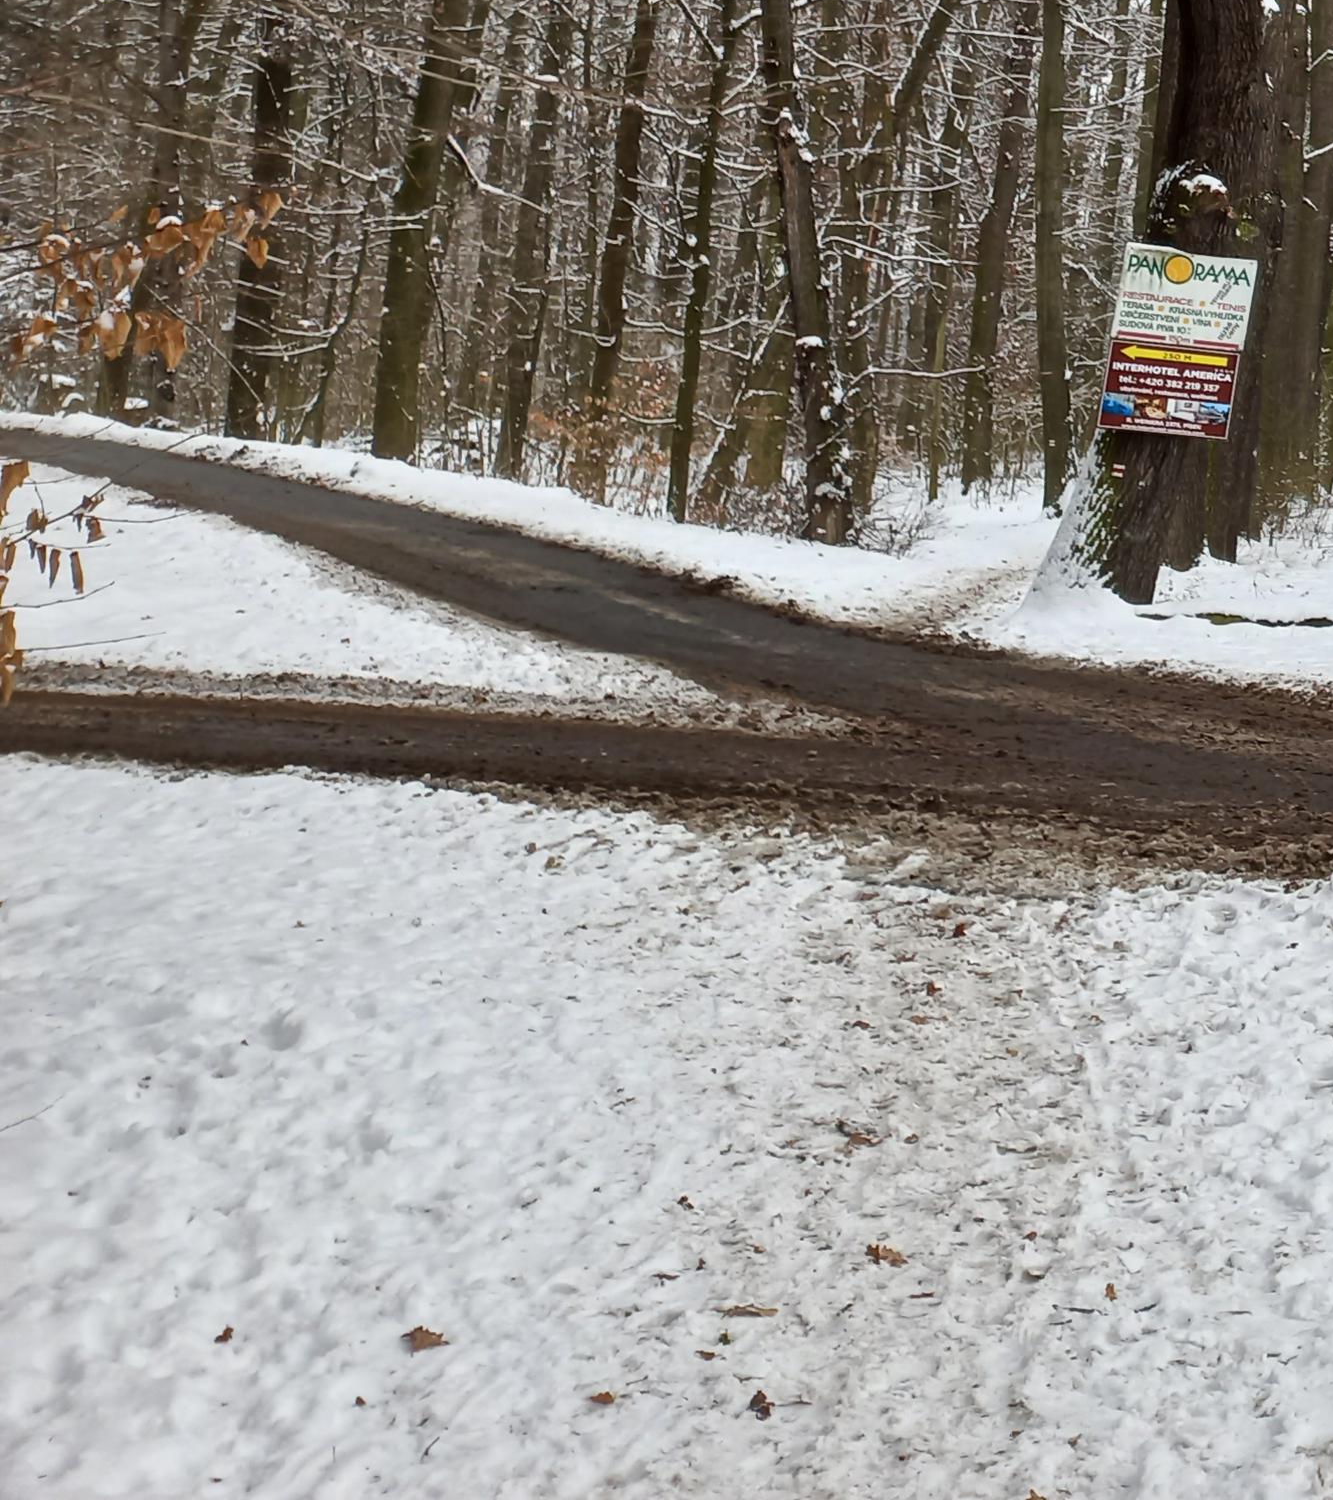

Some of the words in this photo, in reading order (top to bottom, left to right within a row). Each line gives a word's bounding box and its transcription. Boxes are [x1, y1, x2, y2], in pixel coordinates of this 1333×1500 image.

[1127, 254, 1250, 287] PANORAMA
[1122, 292, 1194, 306] RESTAURACE
[1217, 302, 1246, 313] TENIS
[1122, 300, 1154, 311] TERASA
[1163, 352, 1181, 360] 250
[1112, 361, 1181, 377] INTERHOTEL
[1182, 369, 1232, 382] AMERICA
[1139, 376, 1164, 387] +420
